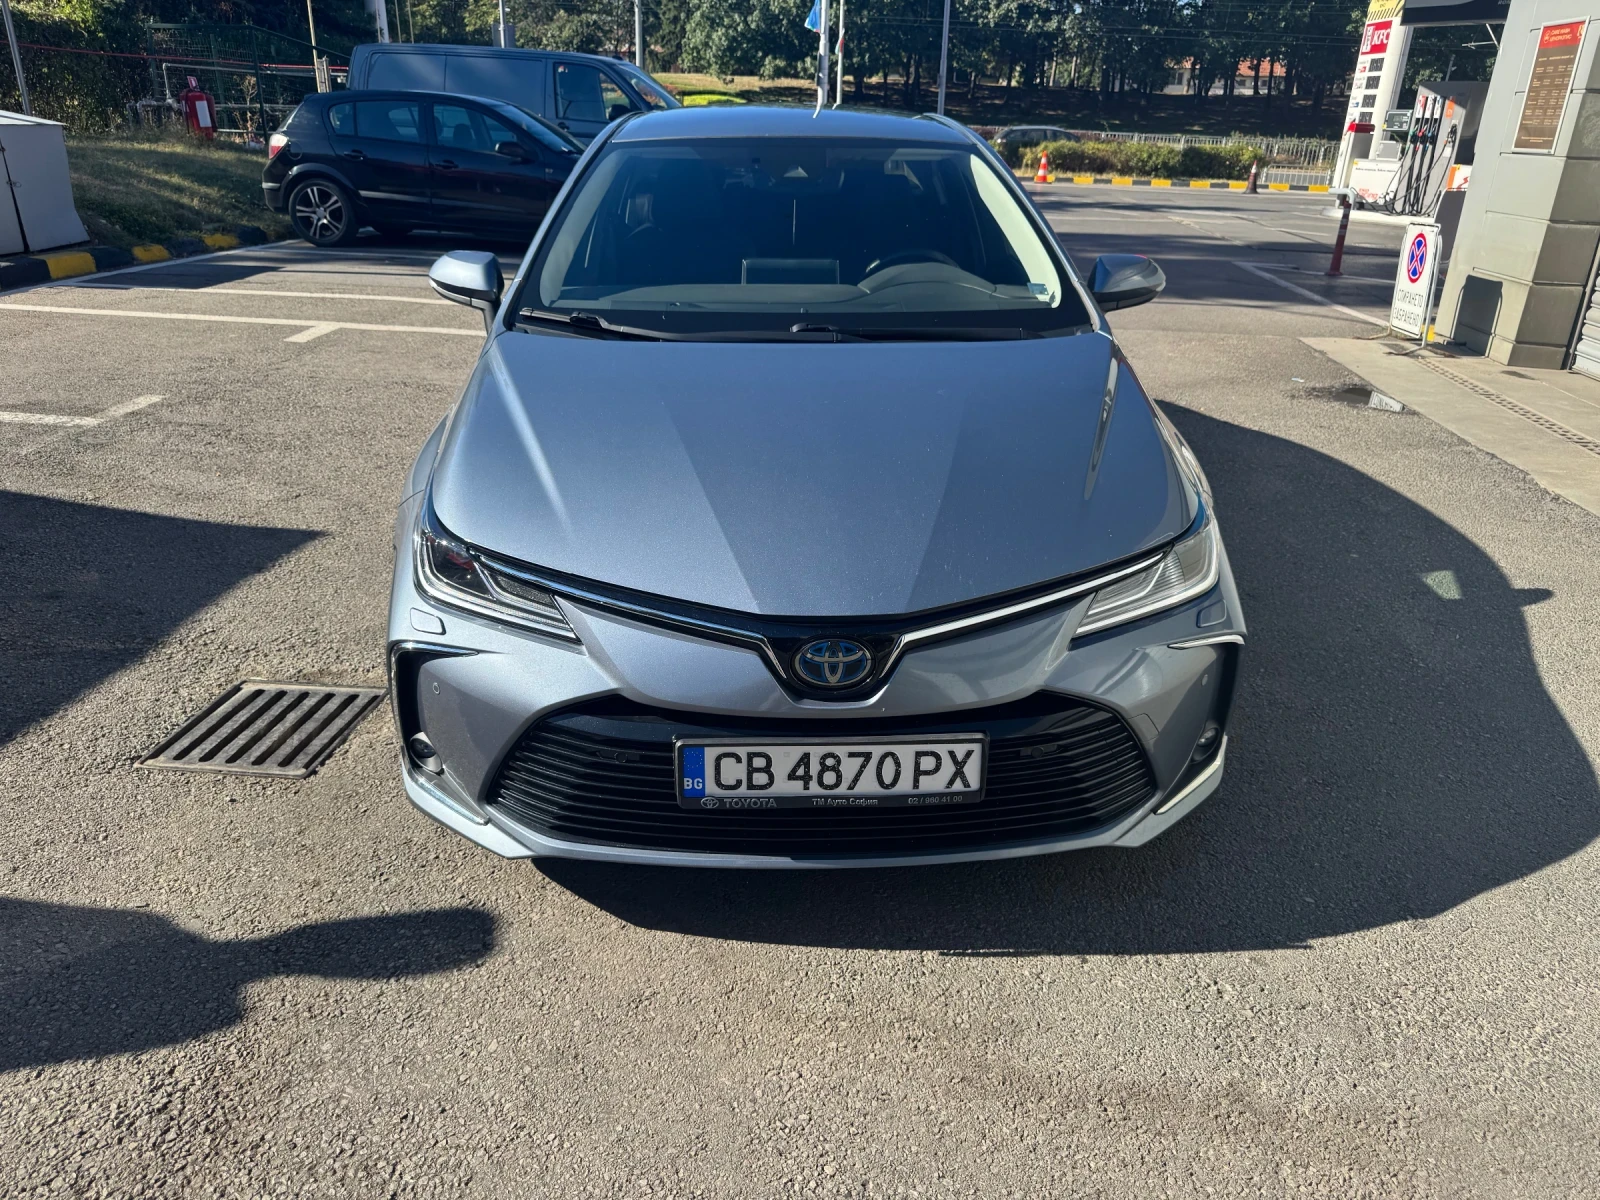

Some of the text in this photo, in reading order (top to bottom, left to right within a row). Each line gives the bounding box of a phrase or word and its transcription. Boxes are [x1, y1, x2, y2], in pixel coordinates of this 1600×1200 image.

[1372, 29, 1390, 45] KFC
[714, 750, 975, 790] CB 4870 PX
[683, 778, 703, 789] BG
[723, 799, 777, 808] TOYOTA
[827, 798, 848, 806] Ауто
[849, 798, 878, 806] София
